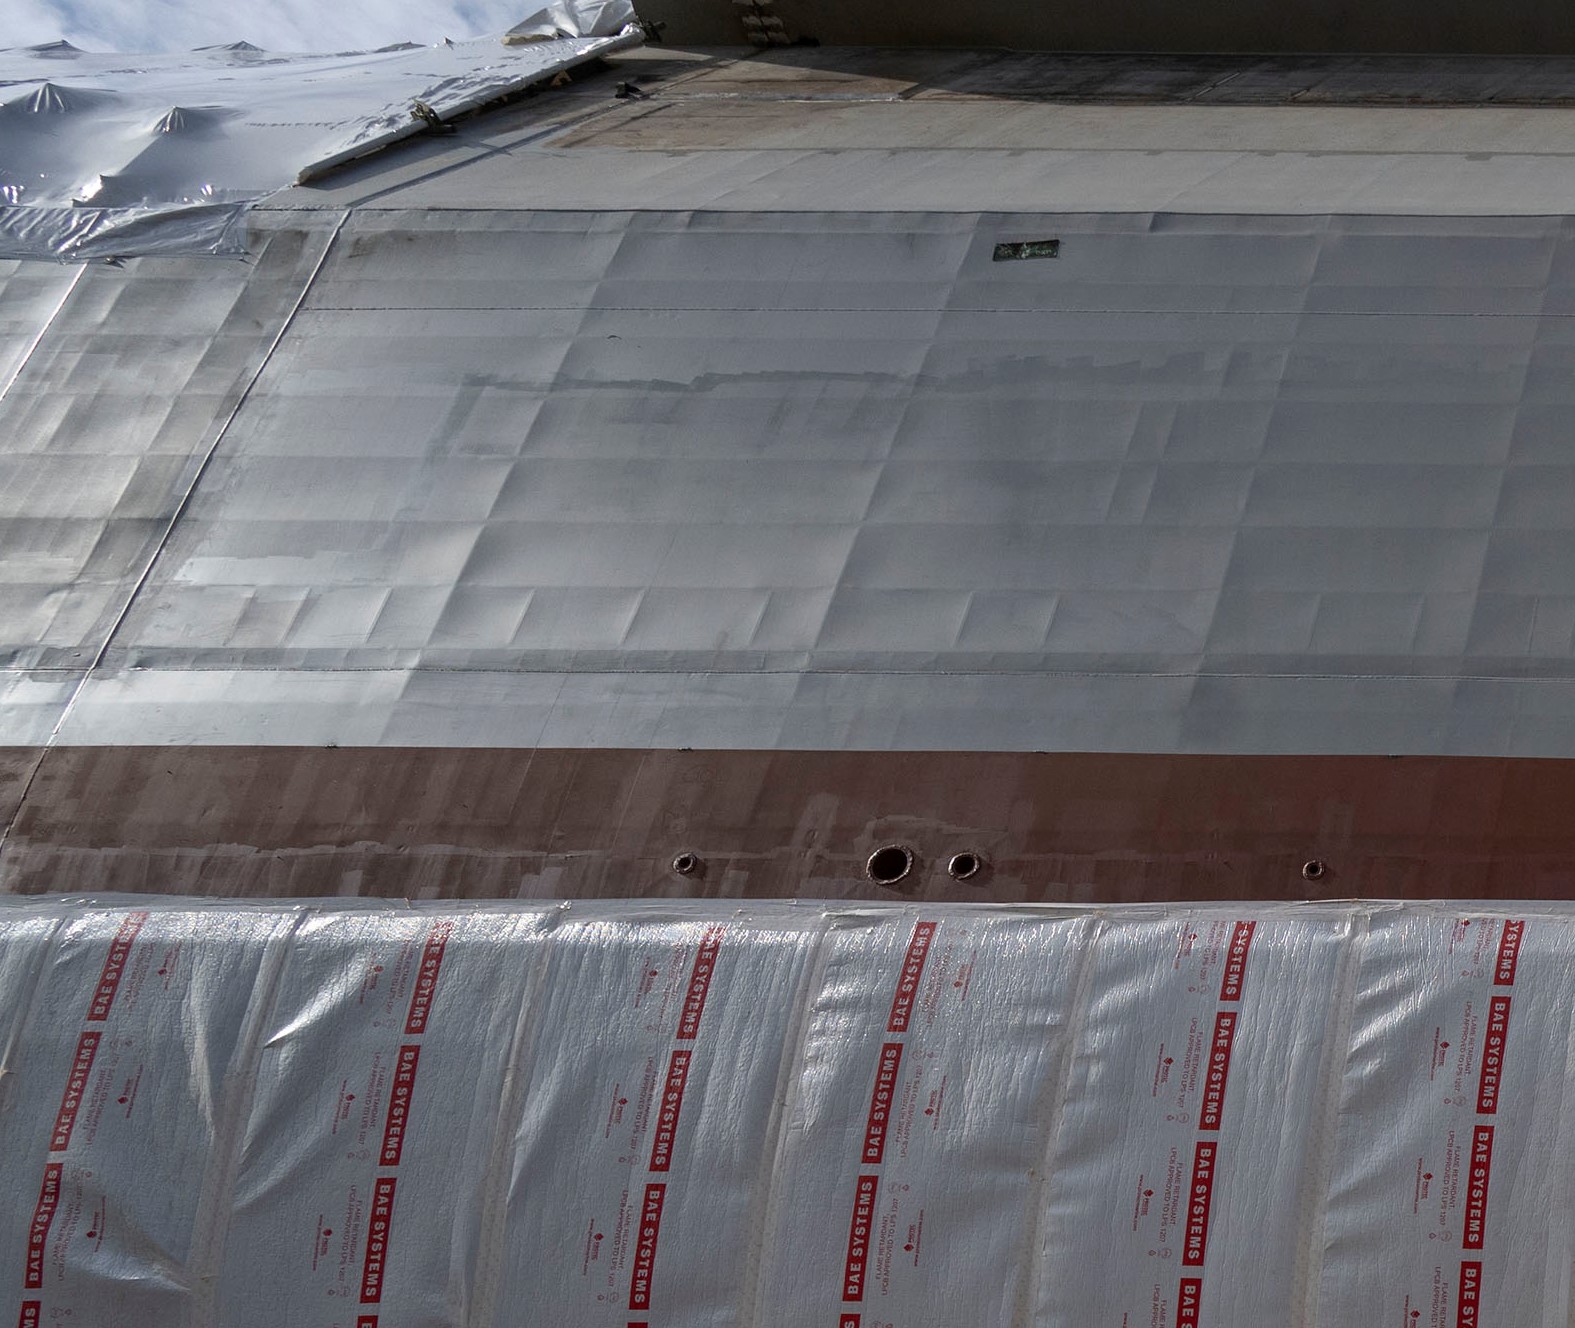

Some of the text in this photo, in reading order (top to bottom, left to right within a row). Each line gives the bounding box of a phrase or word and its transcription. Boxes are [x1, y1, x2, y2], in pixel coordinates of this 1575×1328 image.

[94, 984, 113, 1015] BAE
[410, 959, 436, 1028] SYSTEMS
[682, 963, 709, 1034] SYSTEMS
[893, 927, 931, 1027] BAE SYSTEMS
[1225, 929, 1250, 996] SYSTEMS
[55, 1037, 98, 1146] BAE SYSTEMS
[383, 1051, 415, 1160] BAE SYSTEMS
[867, 1049, 899, 1158] BAE SYSTEMS
[1204, 1018, 1232, 1125] BAE SYSTEMS
[1481, 1002, 1507, 1109] BAE SYSTEMS
[654, 1057, 687, 1166] BAE SYSTEMS
[29, 1168, 59, 1283] BAE SYSTEMS
[365, 1184, 392, 1298] BAE SYSTEMS
[847, 1181, 874, 1295] BAE SYSTEMS
[1187, 1148, 1213, 1261] BAE SYSTEMS
[1467, 1132, 1490, 1244] BAE SYSTEMS
[633, 1190, 661, 1304] BAE SYSTEMS
[1181, 1284, 1197, 1318] BAE
[1463, 1268, 1478, 1301] BAE
